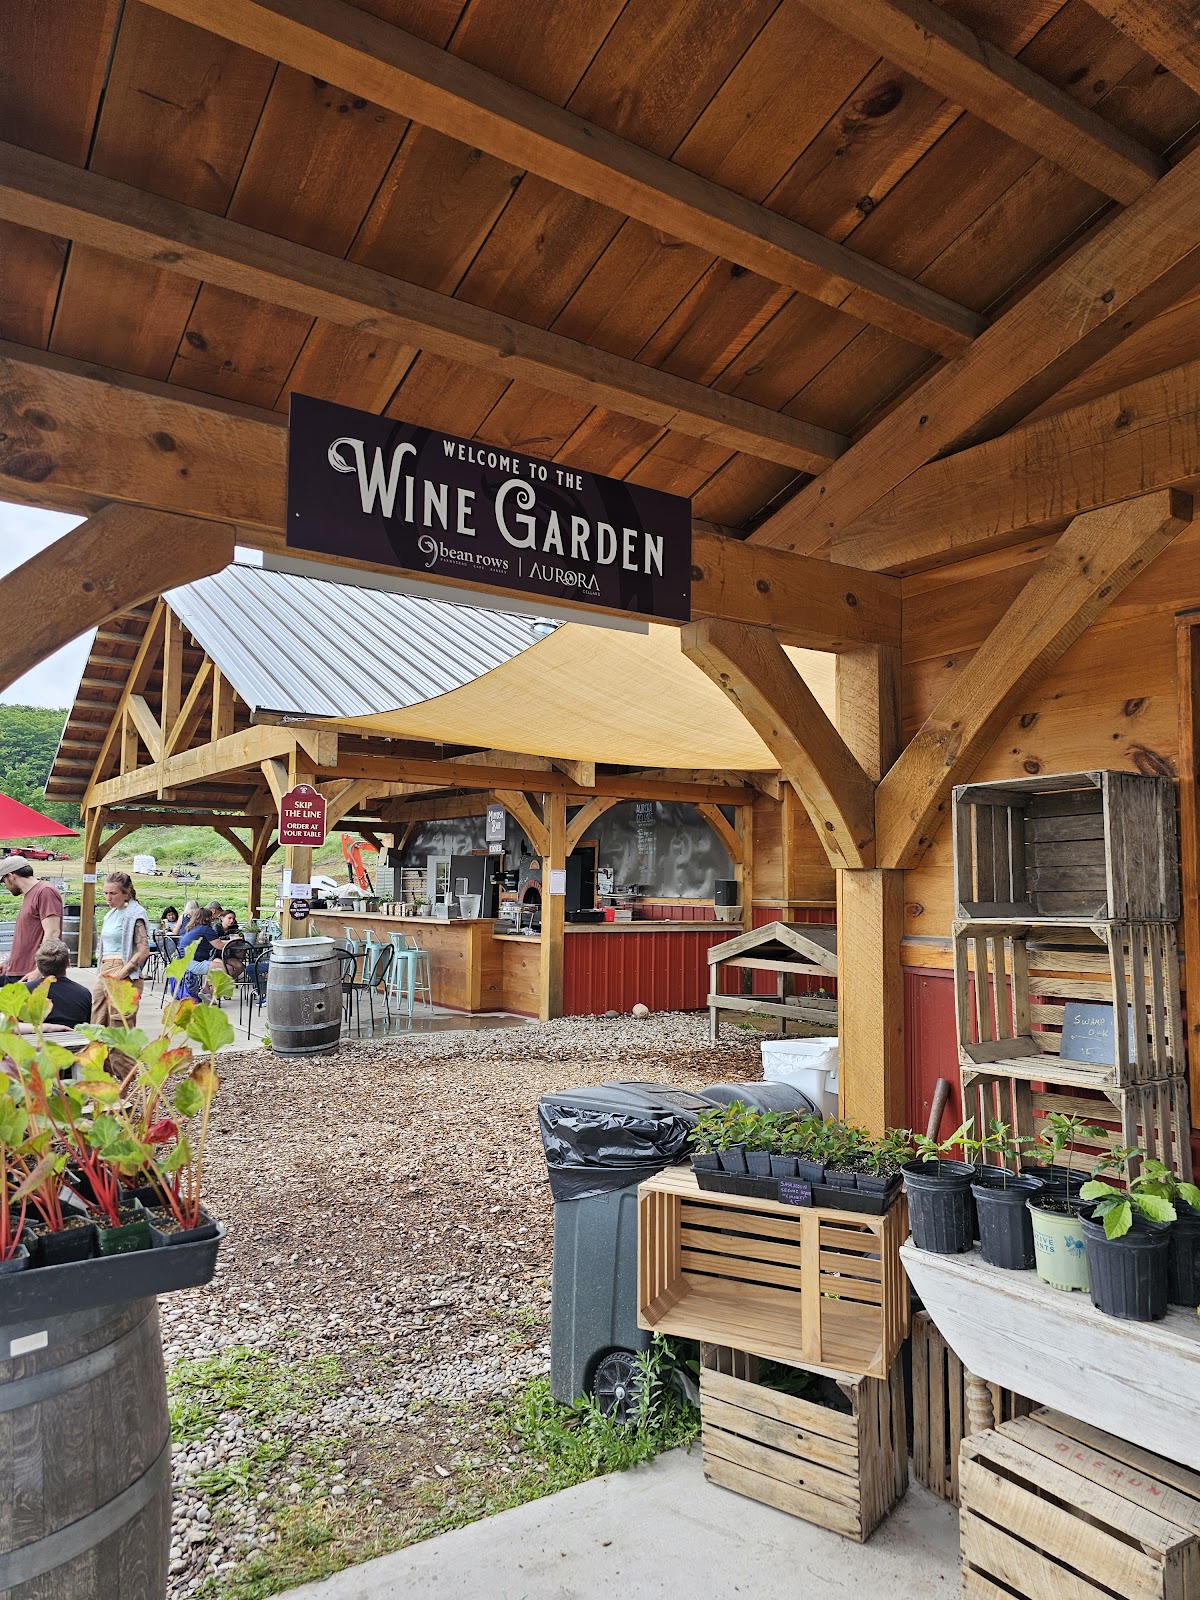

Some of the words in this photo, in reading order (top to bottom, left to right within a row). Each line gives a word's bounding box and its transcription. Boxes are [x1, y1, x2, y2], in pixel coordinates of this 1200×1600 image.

[442, 439, 520, 475] WELCOME
[528, 461, 548, 482] TO
[556, 470, 584, 491] THE
[475, 554, 509, 571] rows
[529, 561, 600, 591] AURORA
[582, 589, 601, 597] CELLARS
[294, 800, 313, 809] SKIP
[284, 809, 301, 818] THE
[302, 810, 322, 819] LINE
[287, 822, 309, 830] ORDER
[303, 830, 322, 838] TABLE
[1073, 1013, 1106, 1026] SWAMP
